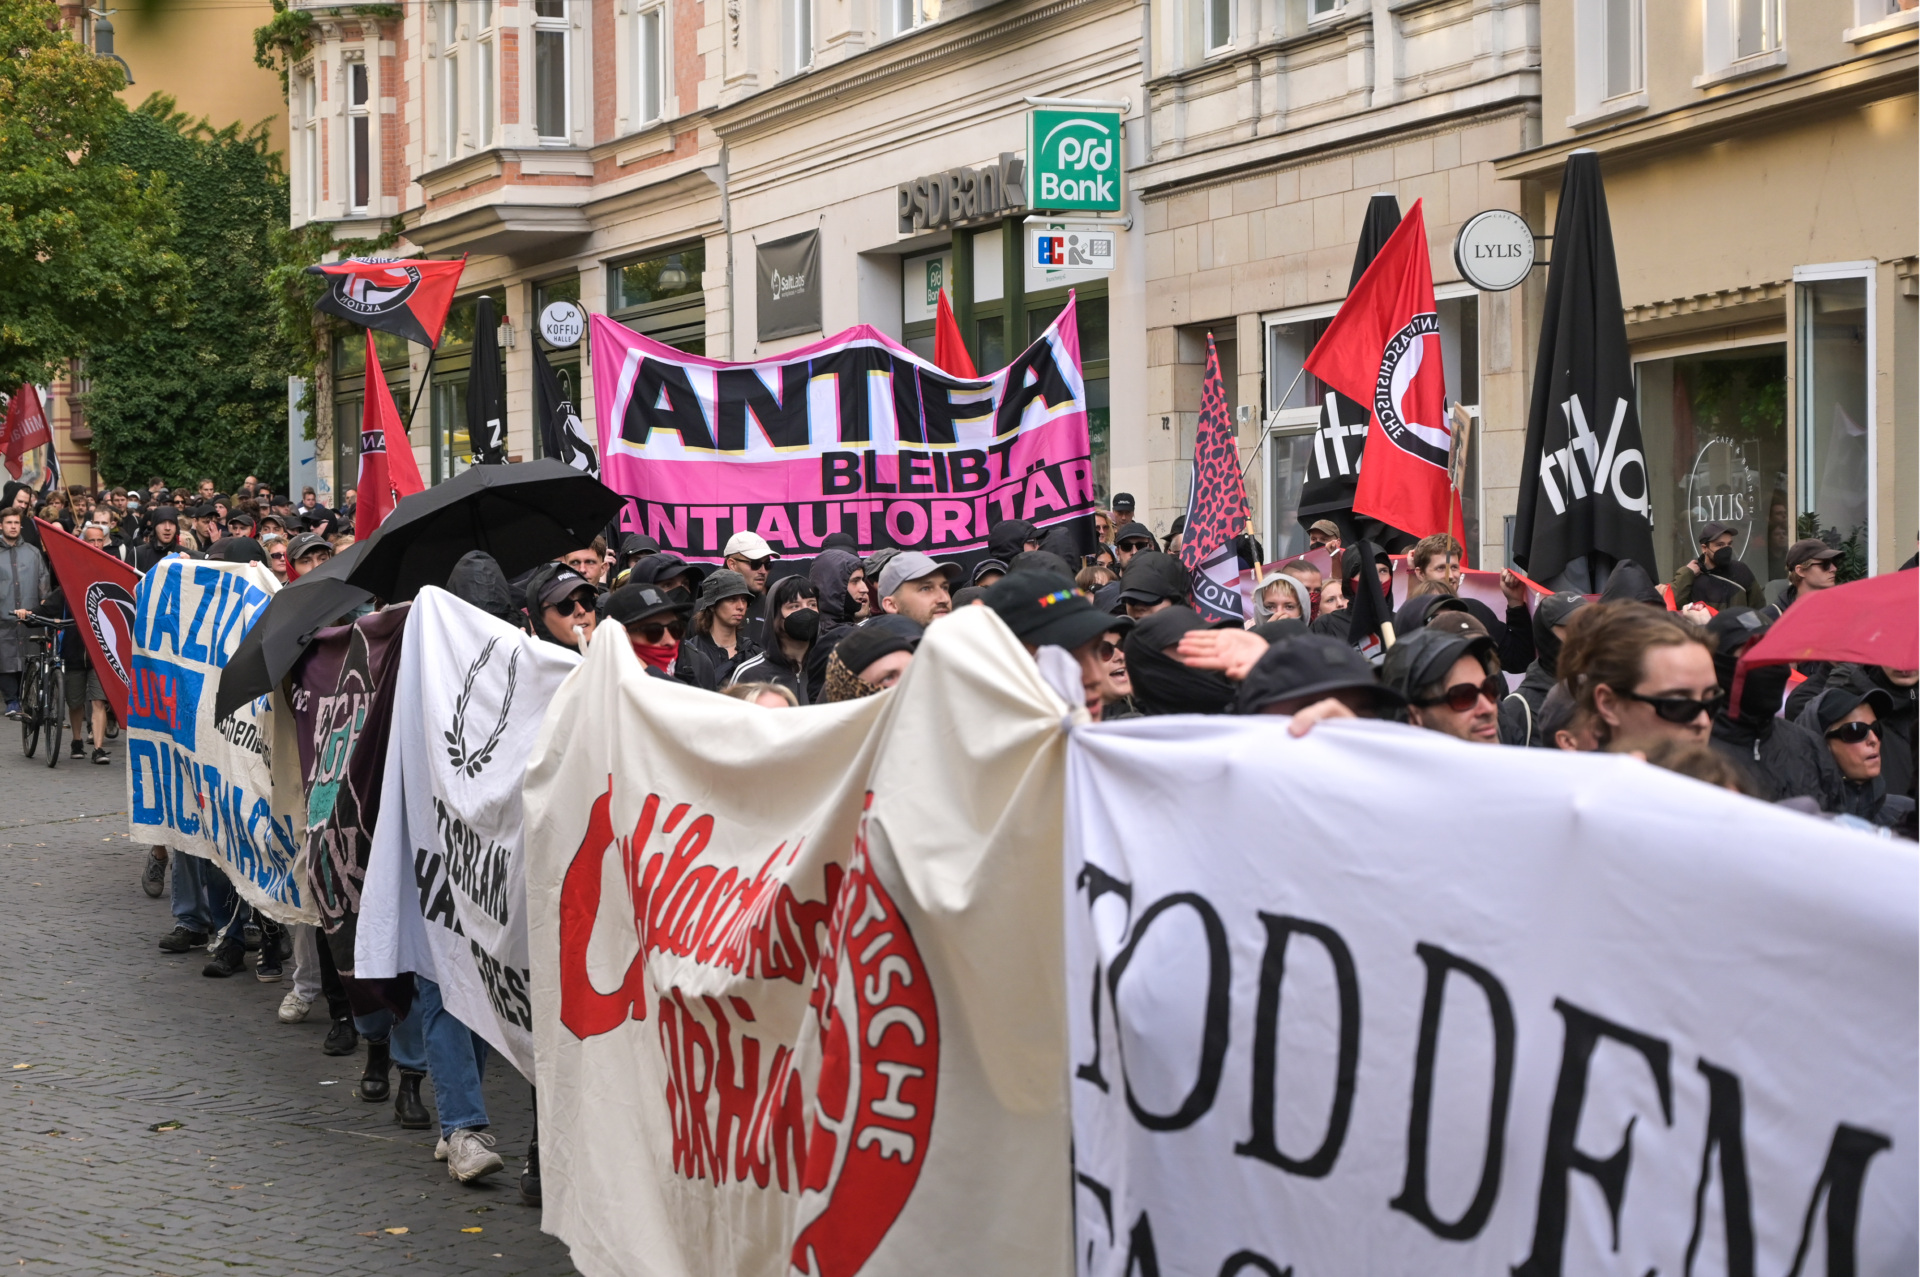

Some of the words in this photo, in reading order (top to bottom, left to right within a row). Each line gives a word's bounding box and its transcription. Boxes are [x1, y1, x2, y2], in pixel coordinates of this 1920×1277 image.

[898, 170, 950, 234] PSD
[949, 151, 1027, 223] Bank
[1041, 172, 1115, 202] Bank
[1474, 243, 1522, 259] LYLIS
[546, 323, 579, 335] KOFFIJ
[619, 336, 1077, 453] ANTIFA
[1161, 416, 1170, 430] 72
[821, 434, 1019, 496] BLEIBT
[619, 455, 1095, 552] ANTIAUTORITÄR
[1696, 492, 1745, 522] LYLIS
[1076, 861, 1361, 1179] TOD
